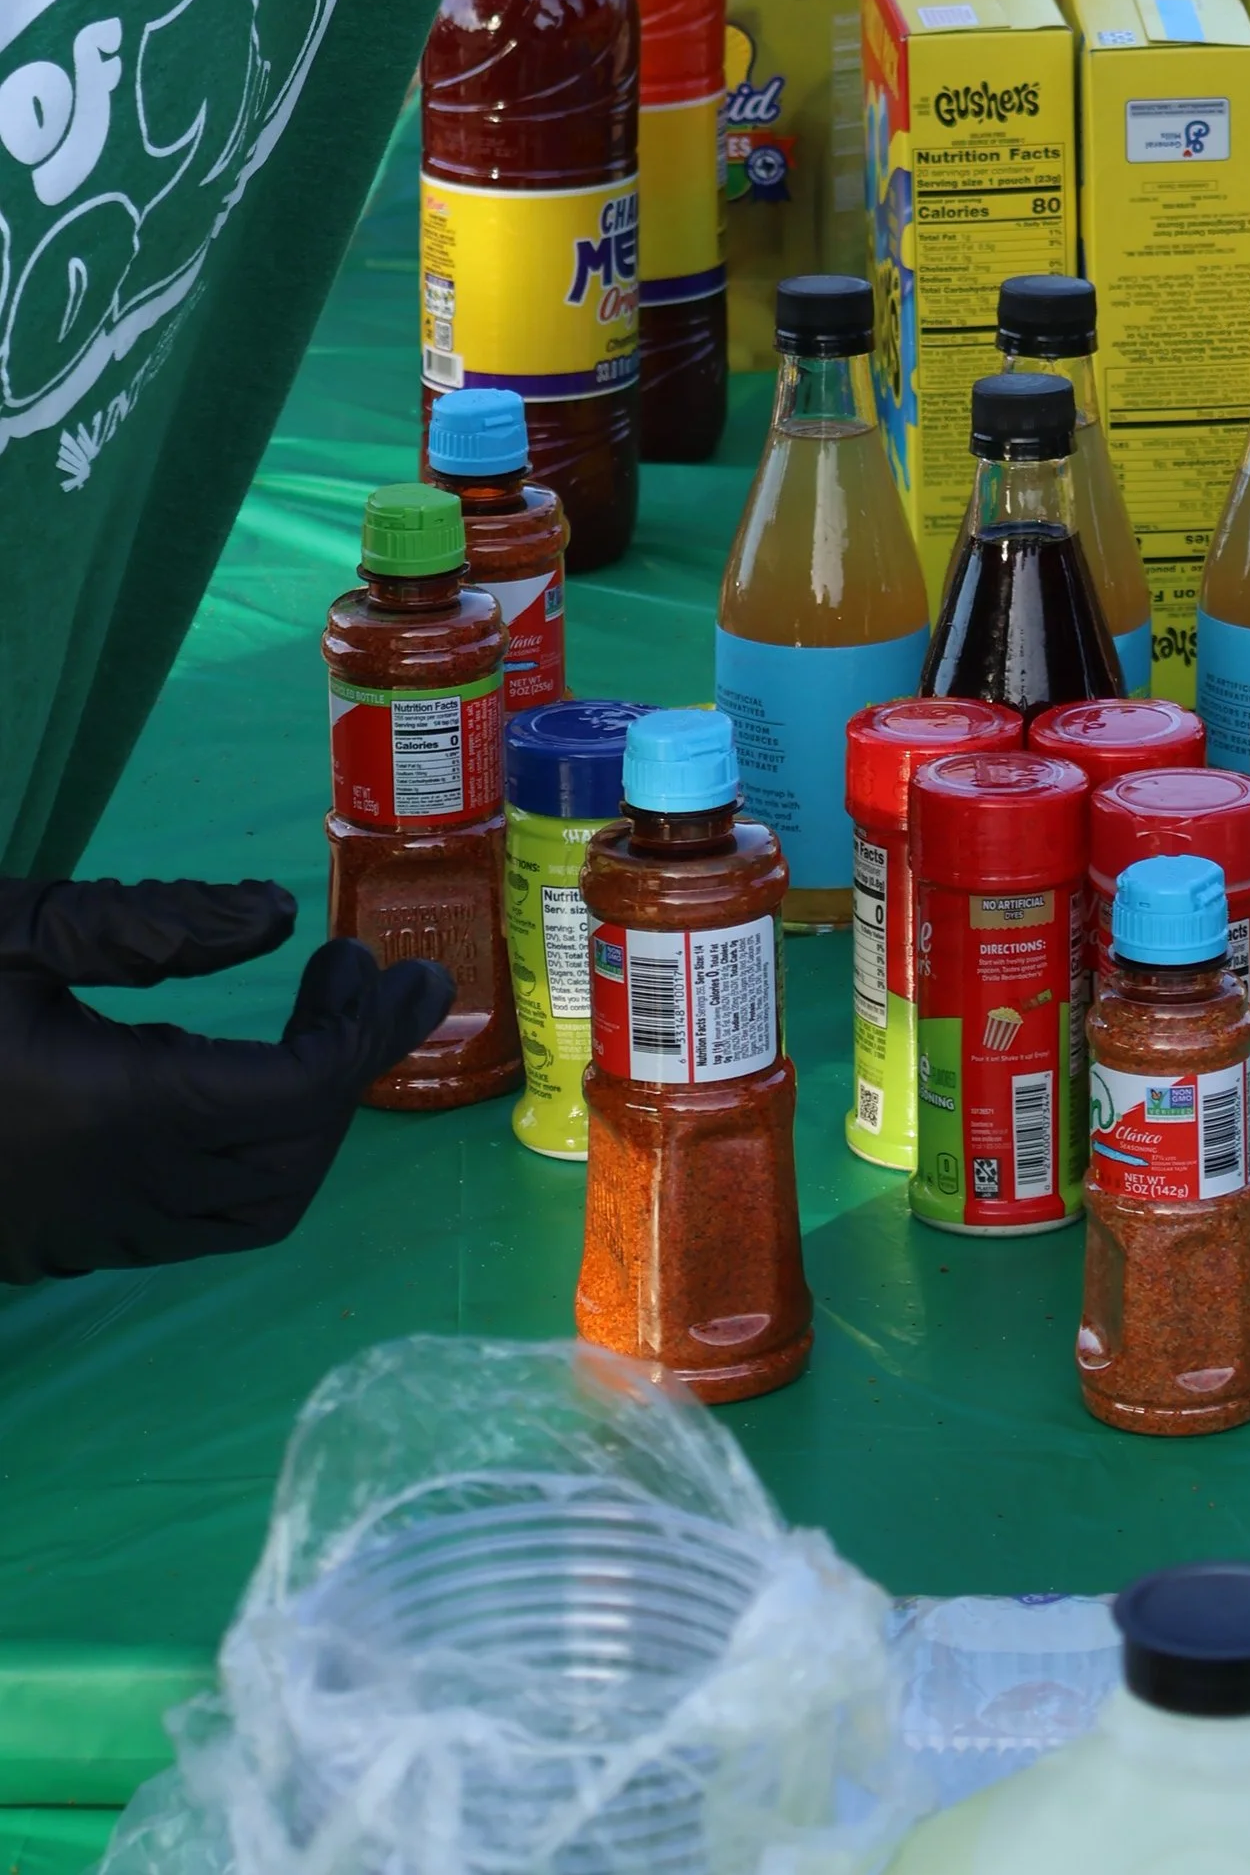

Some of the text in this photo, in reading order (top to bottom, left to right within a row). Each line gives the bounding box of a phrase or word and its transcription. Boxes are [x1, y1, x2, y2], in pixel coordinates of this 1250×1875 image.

[934, 80, 1041, 128] Gushers
[917, 147, 1061, 164] Nutrition Facts
[917, 179, 958, 188] Serving
[962, 178, 983, 187] size
[998, 177, 1031, 185] pouch
[918, 197, 1062, 219] Calories 80
[509, 635, 543, 649] lásico
[510, 675, 541, 687] NET WT
[356, 692, 385, 704] BOTTLE
[394, 700, 458, 713] Nutrition Facts
[745, 722, 770, 736] FROM
[395, 735, 459, 750] Calories 0
[738, 732, 779, 747] SOURCES
[757, 750, 785, 764] FRUIT
[859, 845, 885, 865] Facts
[544, 905, 568, 915] Serv.
[982, 896, 1044, 910] NO ARTIFICIAL
[875, 904, 883, 924] 0
[1004, 911, 1024, 920] DYES
[545, 925, 575, 934] serving:
[1227, 923, 1248, 942] acts
[546, 942, 577, 951] Cholest.
[710, 944, 719, 953] Fat
[979, 939, 1046, 955] DIRECTIONS:
[564, 951, 584, 960] Total
[695, 955, 703, 970] Size:
[564, 960, 584, 968] Total
[695, 971, 704, 985] Serv
[551, 987, 572, 995] Potas.
[675, 970, 684, 1003] 10017
[709, 979, 720, 1006] Calories
[552, 995, 580, 1005] tells you
[696, 996, 708, 1017] Servings
[553, 1003, 568, 1012] food
[675, 1010, 686, 1044] 33148
[695, 1018, 706, 1036] Facts
[696, 1038, 708, 1066] Nutrition
[713, 1041, 724, 1053] (1g)
[713, 1055, 724, 1065] tsp
[1001, 1053, 1019, 1062] Shake
[1171, 1088, 1192, 1096] NON
[1171, 1095, 1193, 1103] GMO
[1148, 1108, 1194, 1116] VERIFIED
[1115, 1126, 1163, 1144] Clásico
[1119, 1142, 1158, 1154] SEASONING
[1124, 1172, 1166, 1185] NET WT
[1151, 1184, 1189, 1198] (142g)
